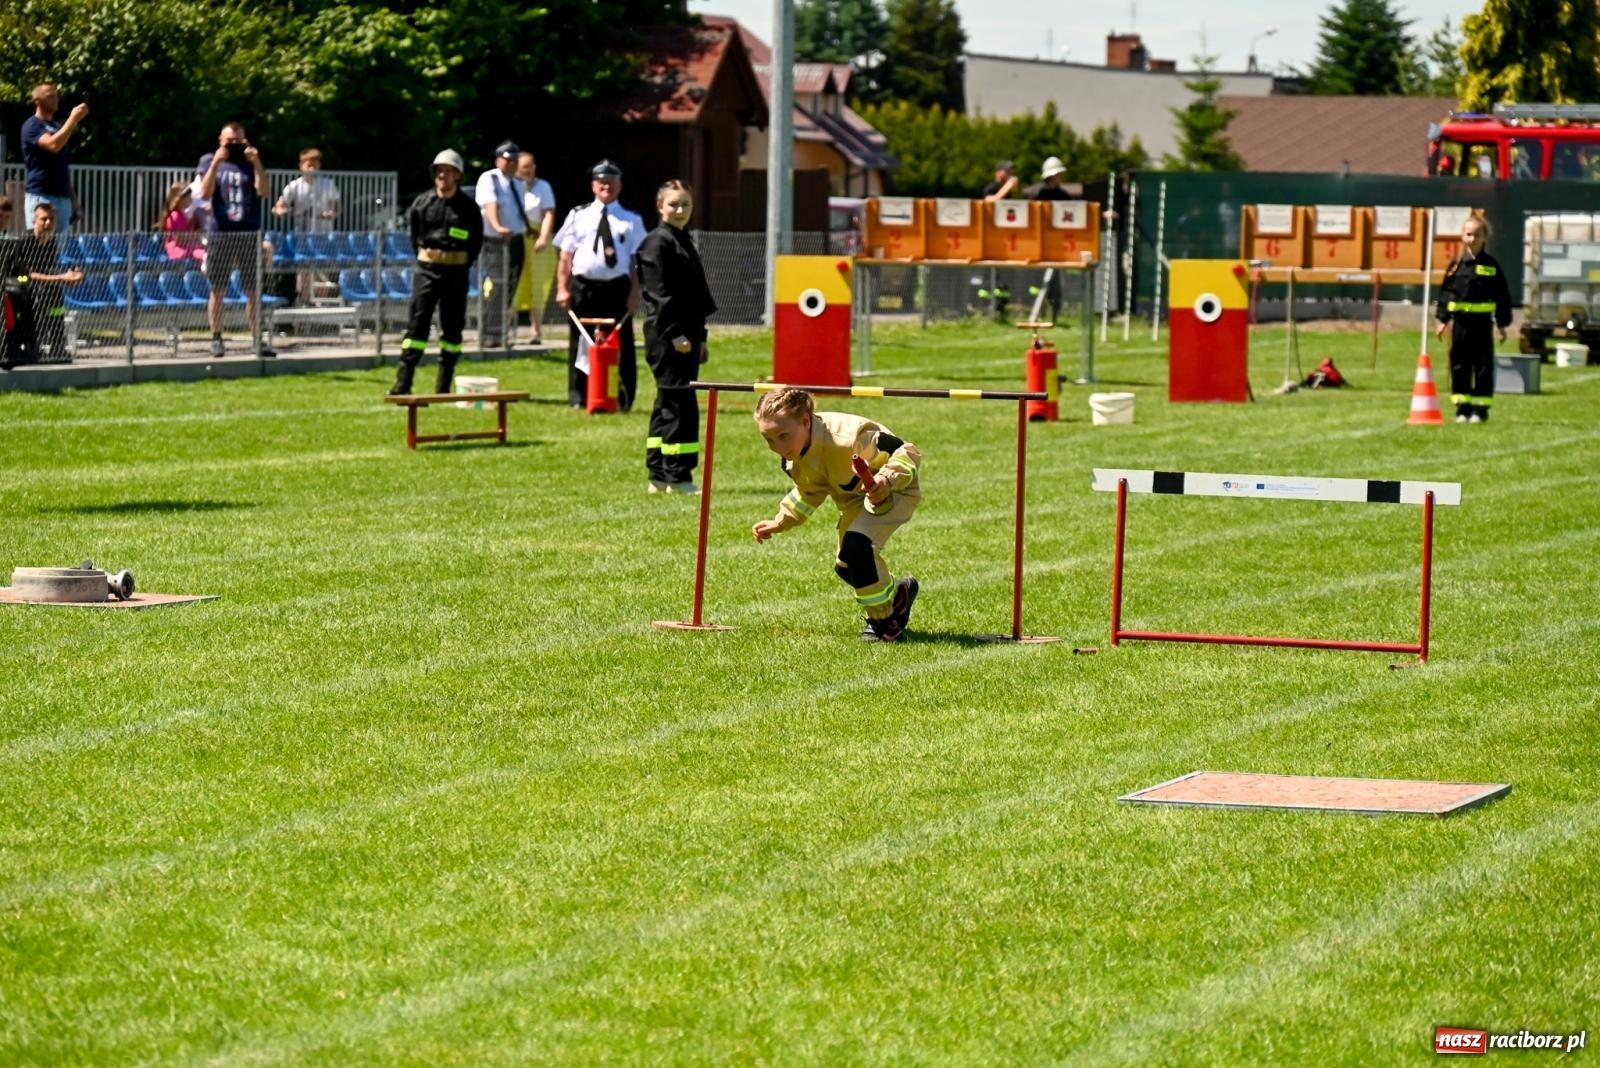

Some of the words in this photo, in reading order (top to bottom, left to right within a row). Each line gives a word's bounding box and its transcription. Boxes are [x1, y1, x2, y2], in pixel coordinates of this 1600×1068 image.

[890, 230, 902, 249] 2
[948, 230, 960, 249] 3
[1063, 232, 1076, 252] 5
[1266, 238, 1280, 257] 6
[1327, 238, 1340, 258] 7
[1385, 239, 1399, 259] 8
[1444, 240, 1459, 260] 9
